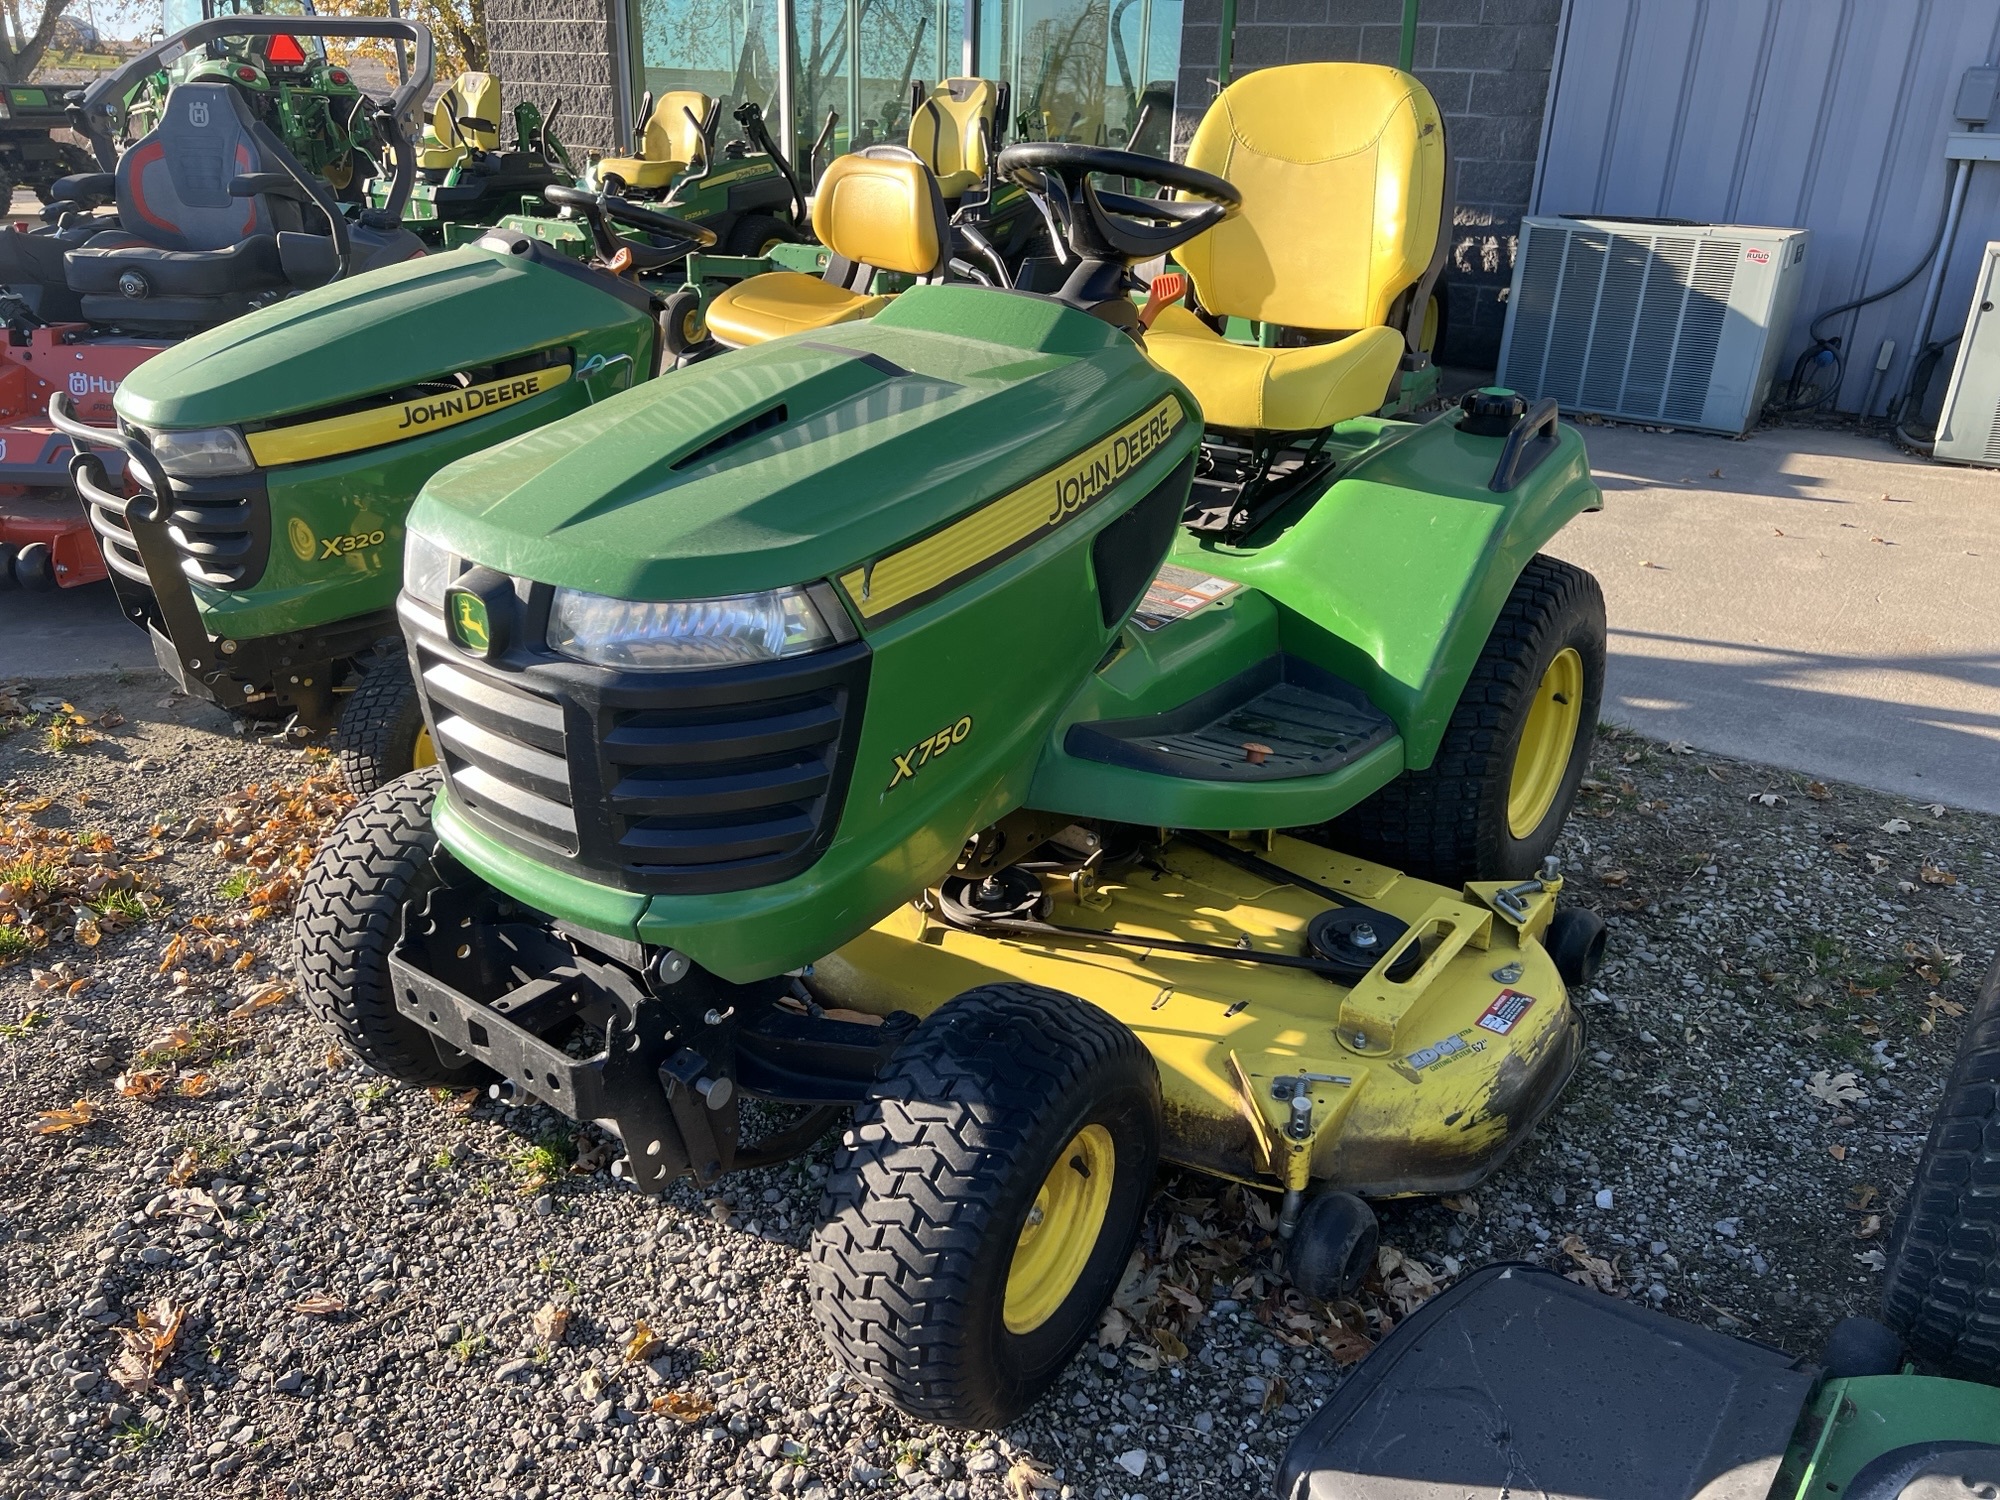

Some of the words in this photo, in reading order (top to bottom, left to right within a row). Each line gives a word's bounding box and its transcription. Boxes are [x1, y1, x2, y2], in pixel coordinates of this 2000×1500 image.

[1746, 252, 1770, 260] RUUD
[398, 398, 464, 429] JOHN
[465, 376, 540, 411] DEERE
[1049, 454, 1110, 522] JOHN
[1113, 407, 1171, 476] DEERE
[319, 529, 385, 561] X320
[887, 715, 972, 789] X750
[1405, 1034, 1469, 1071] EDGE
[1429, 1058, 1452, 1072] CUTTING
[1451, 1048, 1473, 1062] SYSTEM
